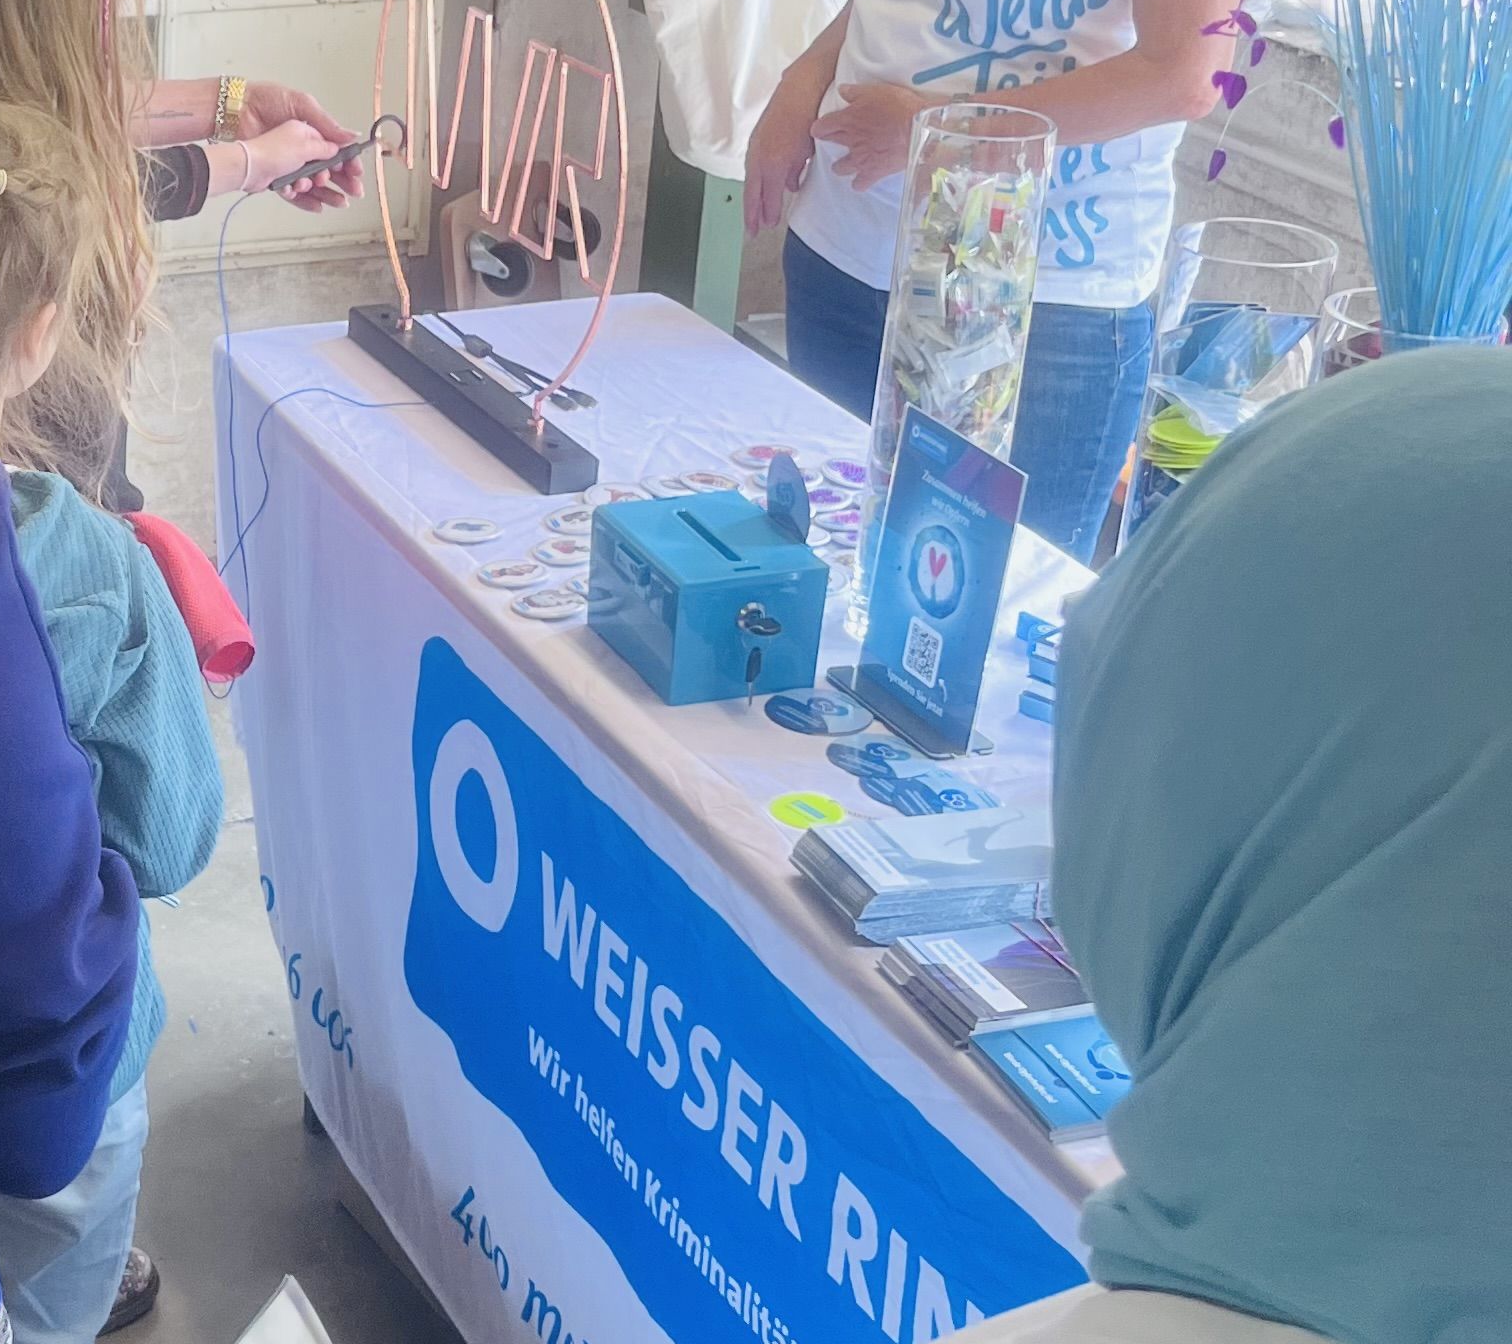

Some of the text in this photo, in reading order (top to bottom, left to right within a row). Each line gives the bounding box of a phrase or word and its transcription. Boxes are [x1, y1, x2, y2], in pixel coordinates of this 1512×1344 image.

[528, 1024, 571, 1097] Wir
[574, 1074, 638, 1191] helfen
[540, 850, 807, 1243] WEISSER
